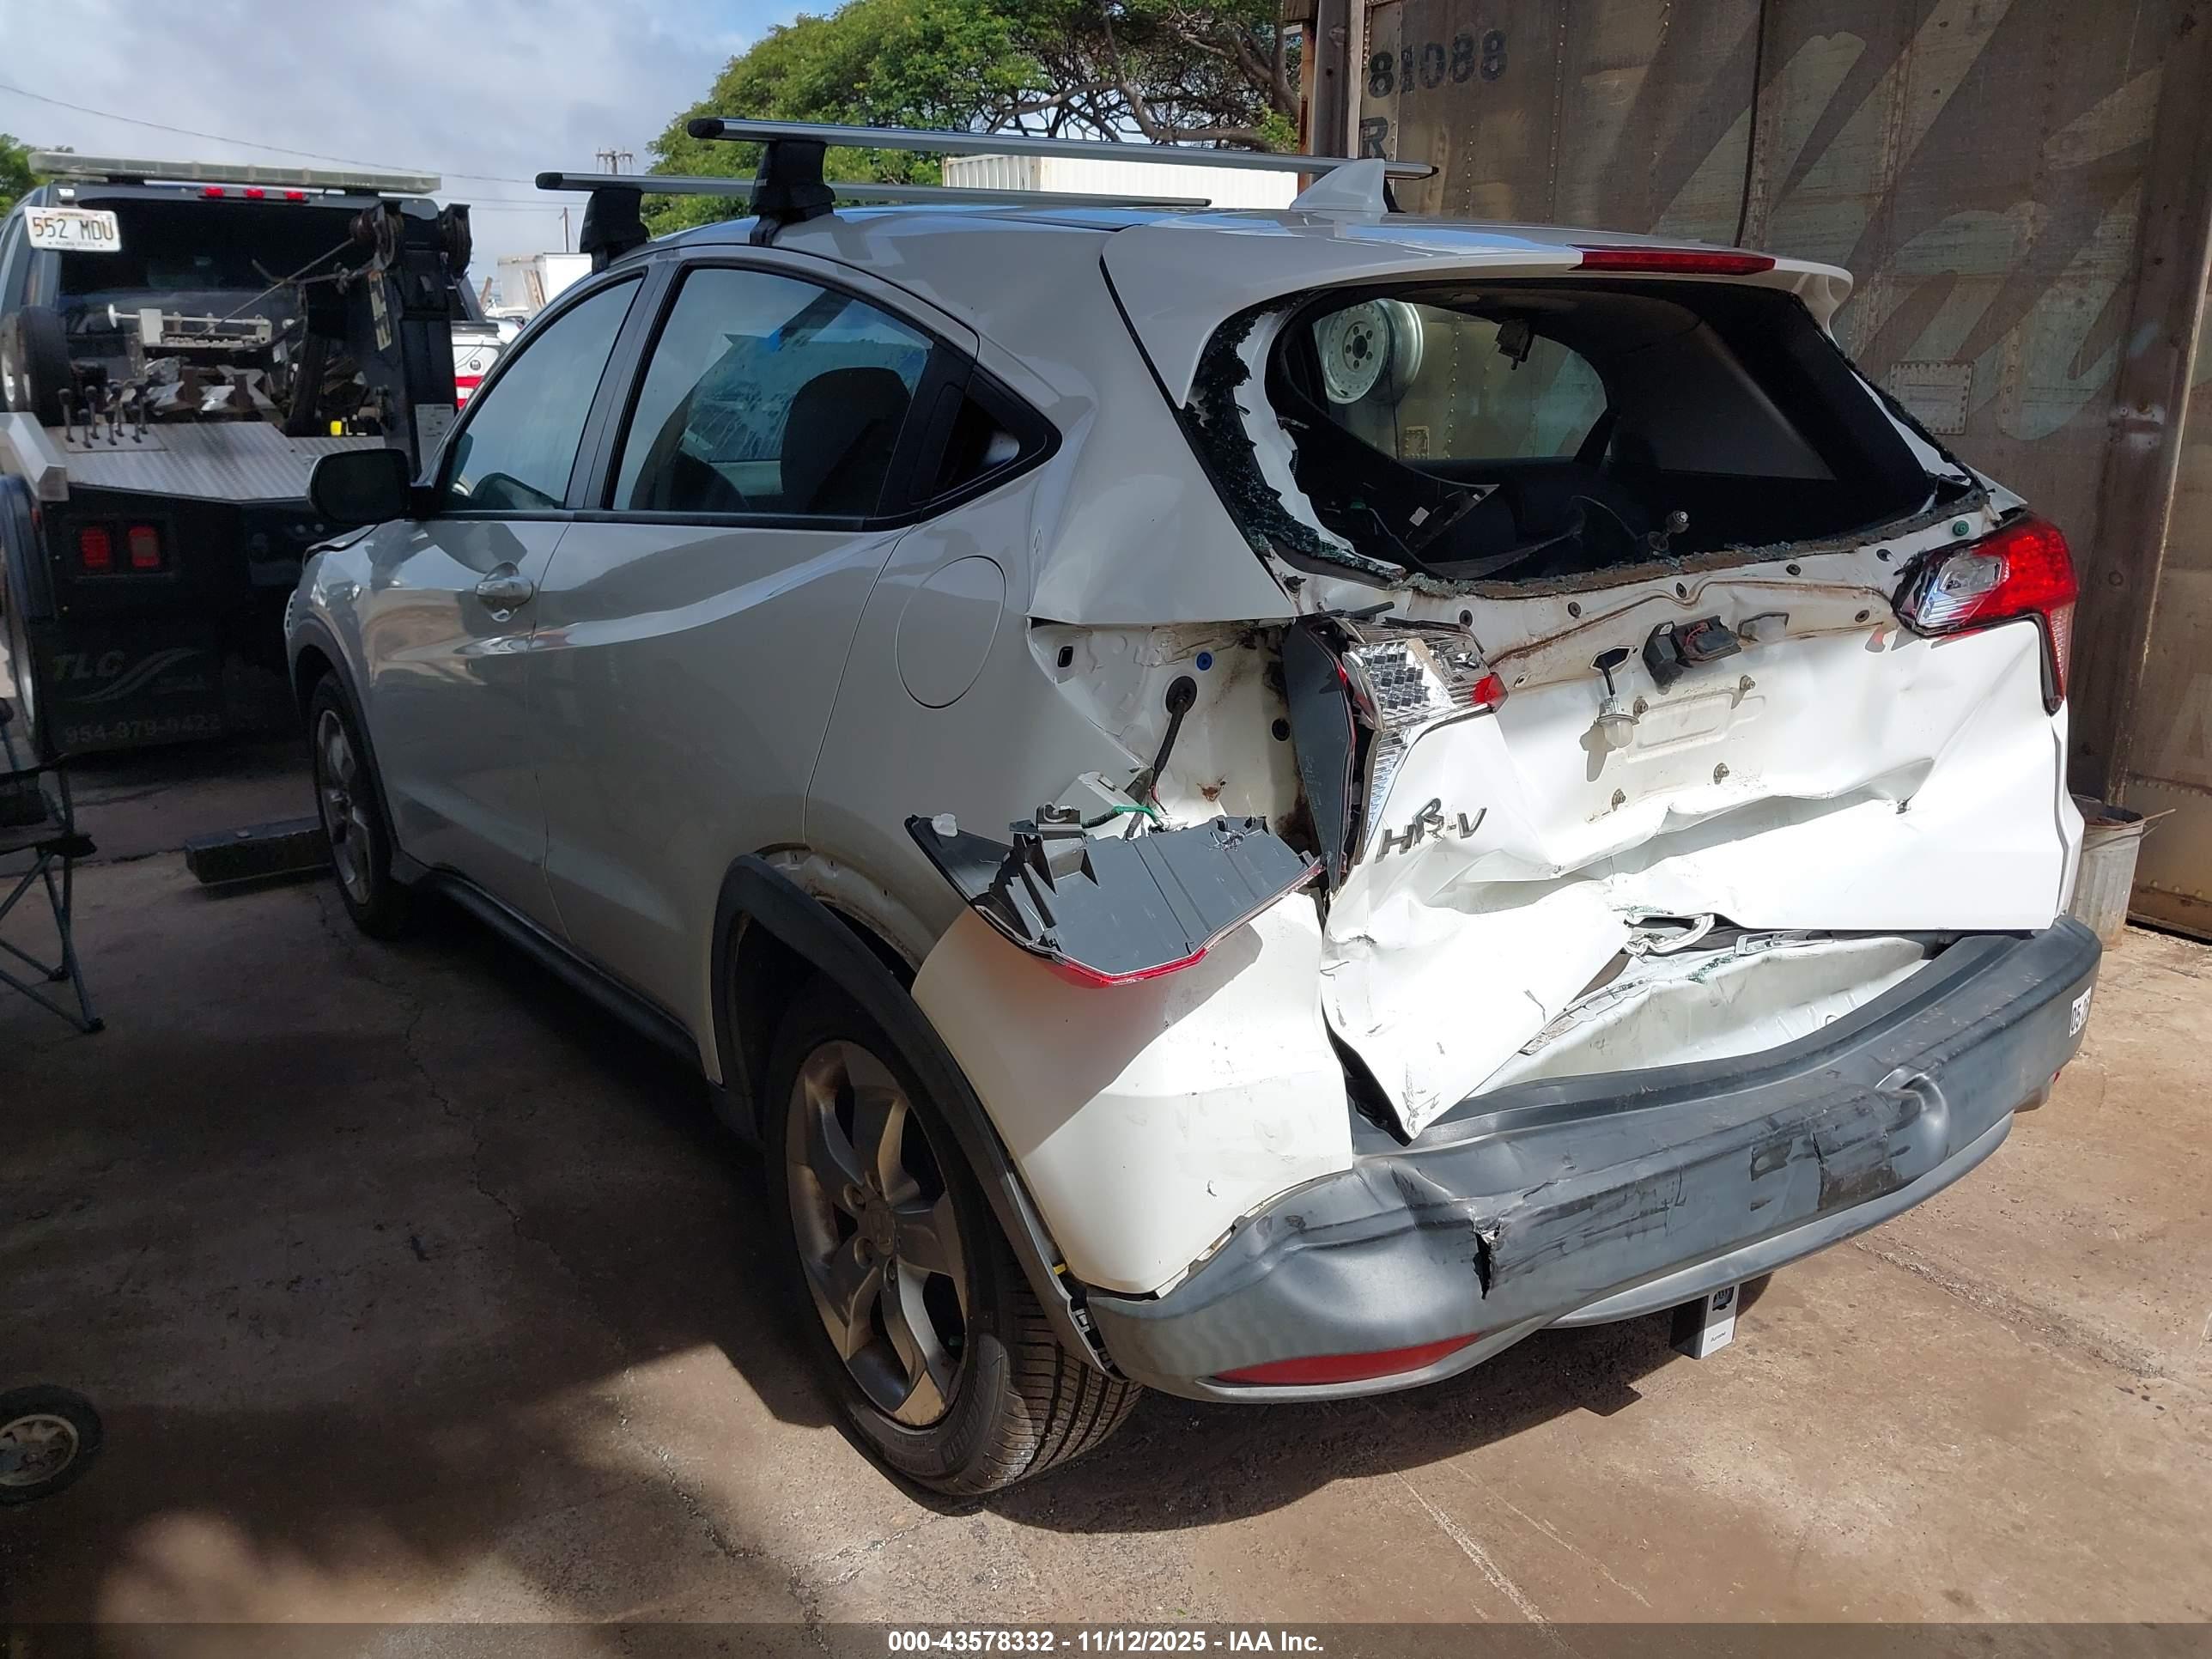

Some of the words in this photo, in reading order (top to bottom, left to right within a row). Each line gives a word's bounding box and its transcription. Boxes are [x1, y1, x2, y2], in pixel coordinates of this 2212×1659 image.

[1368, 29, 1508, 99] 81088
[33, 216, 70, 239] 552
[1374, 798, 1488, 864] HR-V
